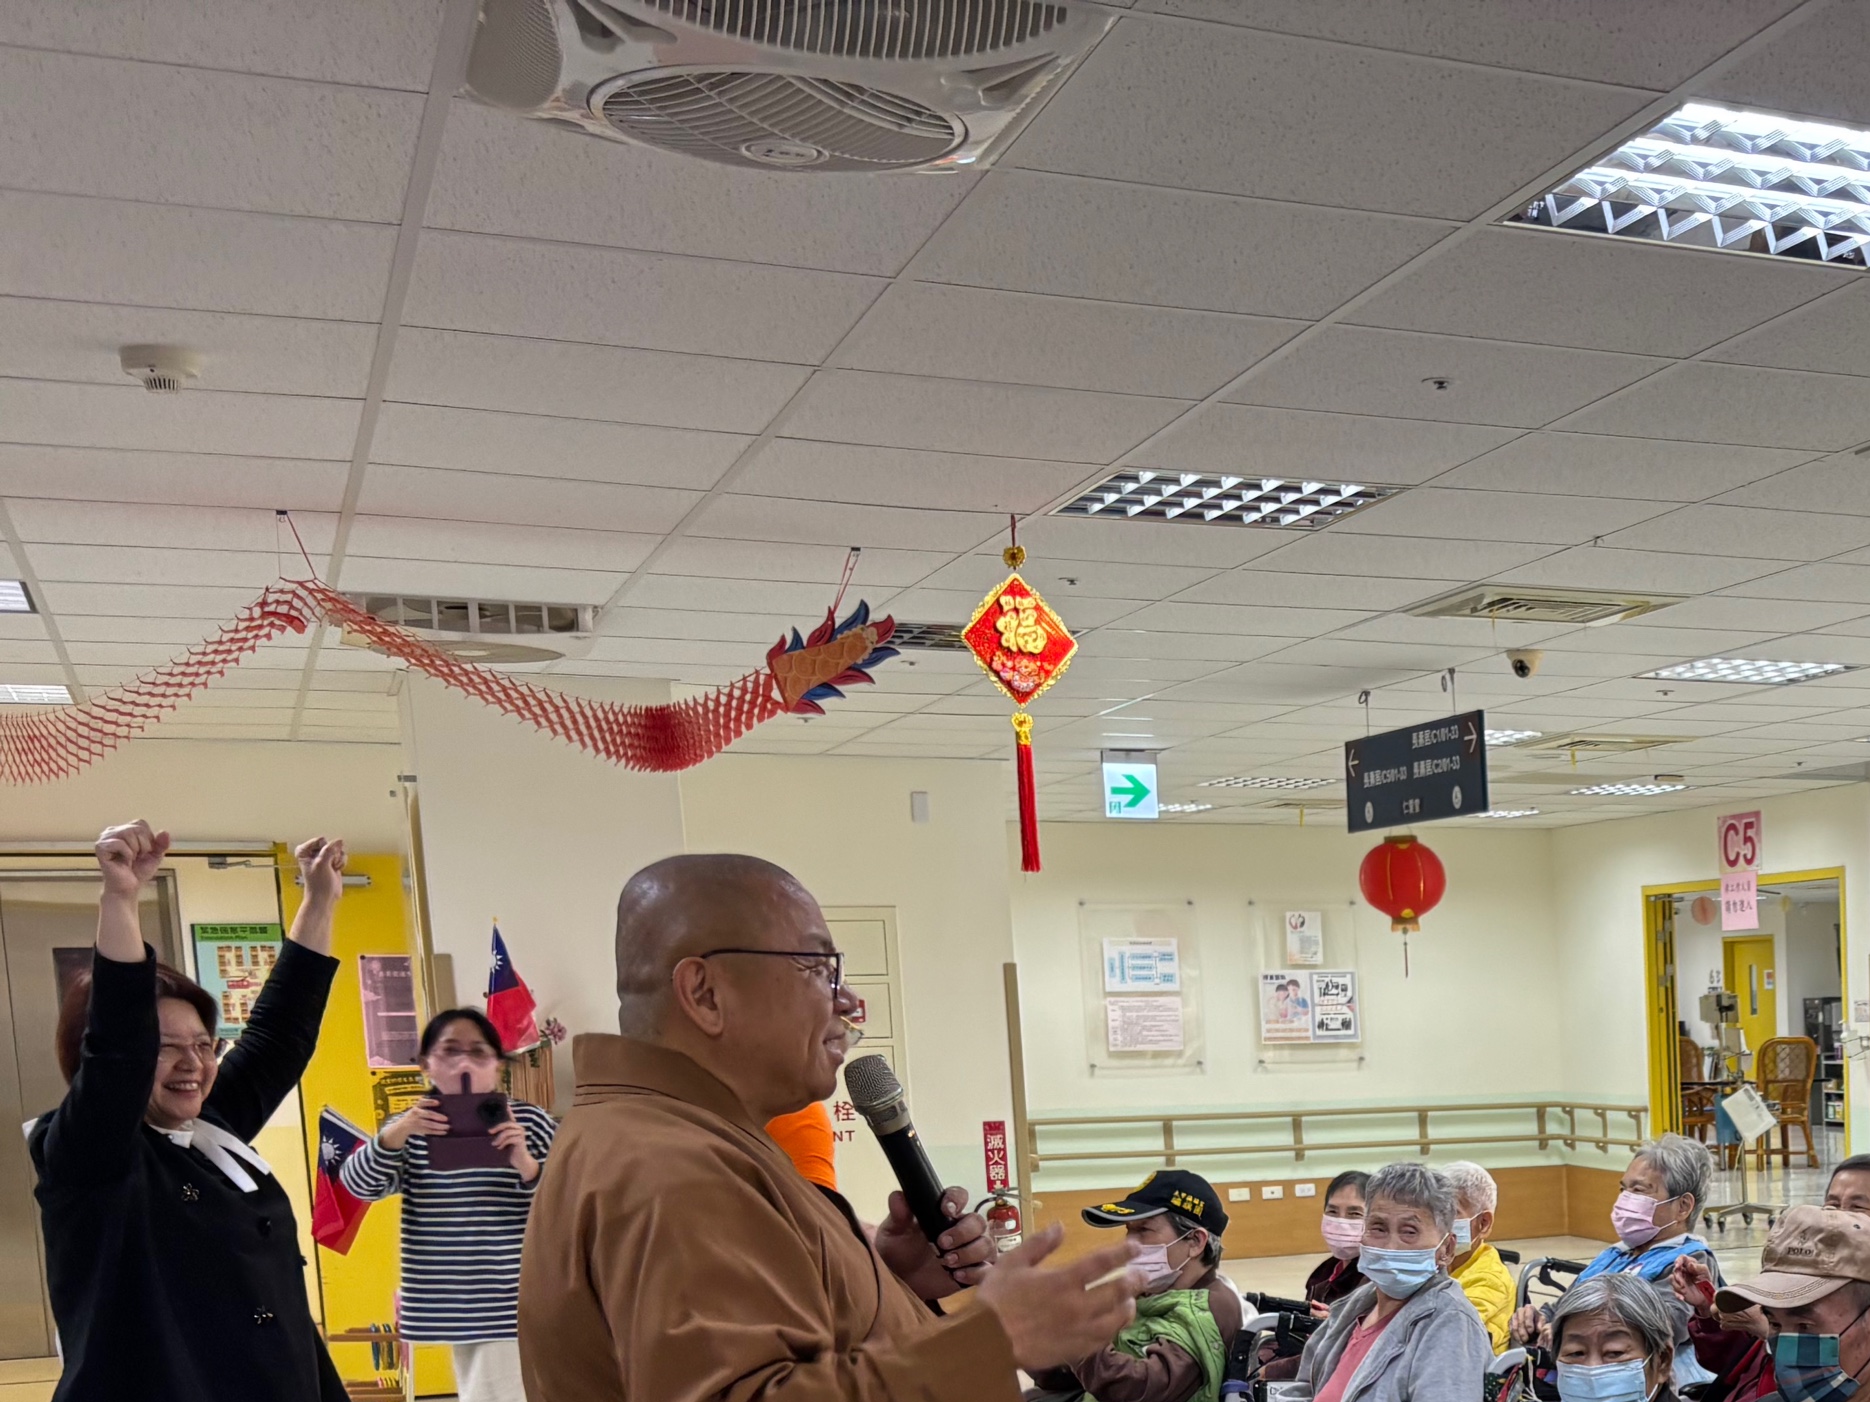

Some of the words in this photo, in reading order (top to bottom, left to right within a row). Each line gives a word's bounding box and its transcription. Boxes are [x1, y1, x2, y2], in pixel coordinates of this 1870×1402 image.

[995, 595, 1048, 655] 福
[1723, 820, 1757, 868] C5
[987, 1134, 1006, 1181] 滅火器
